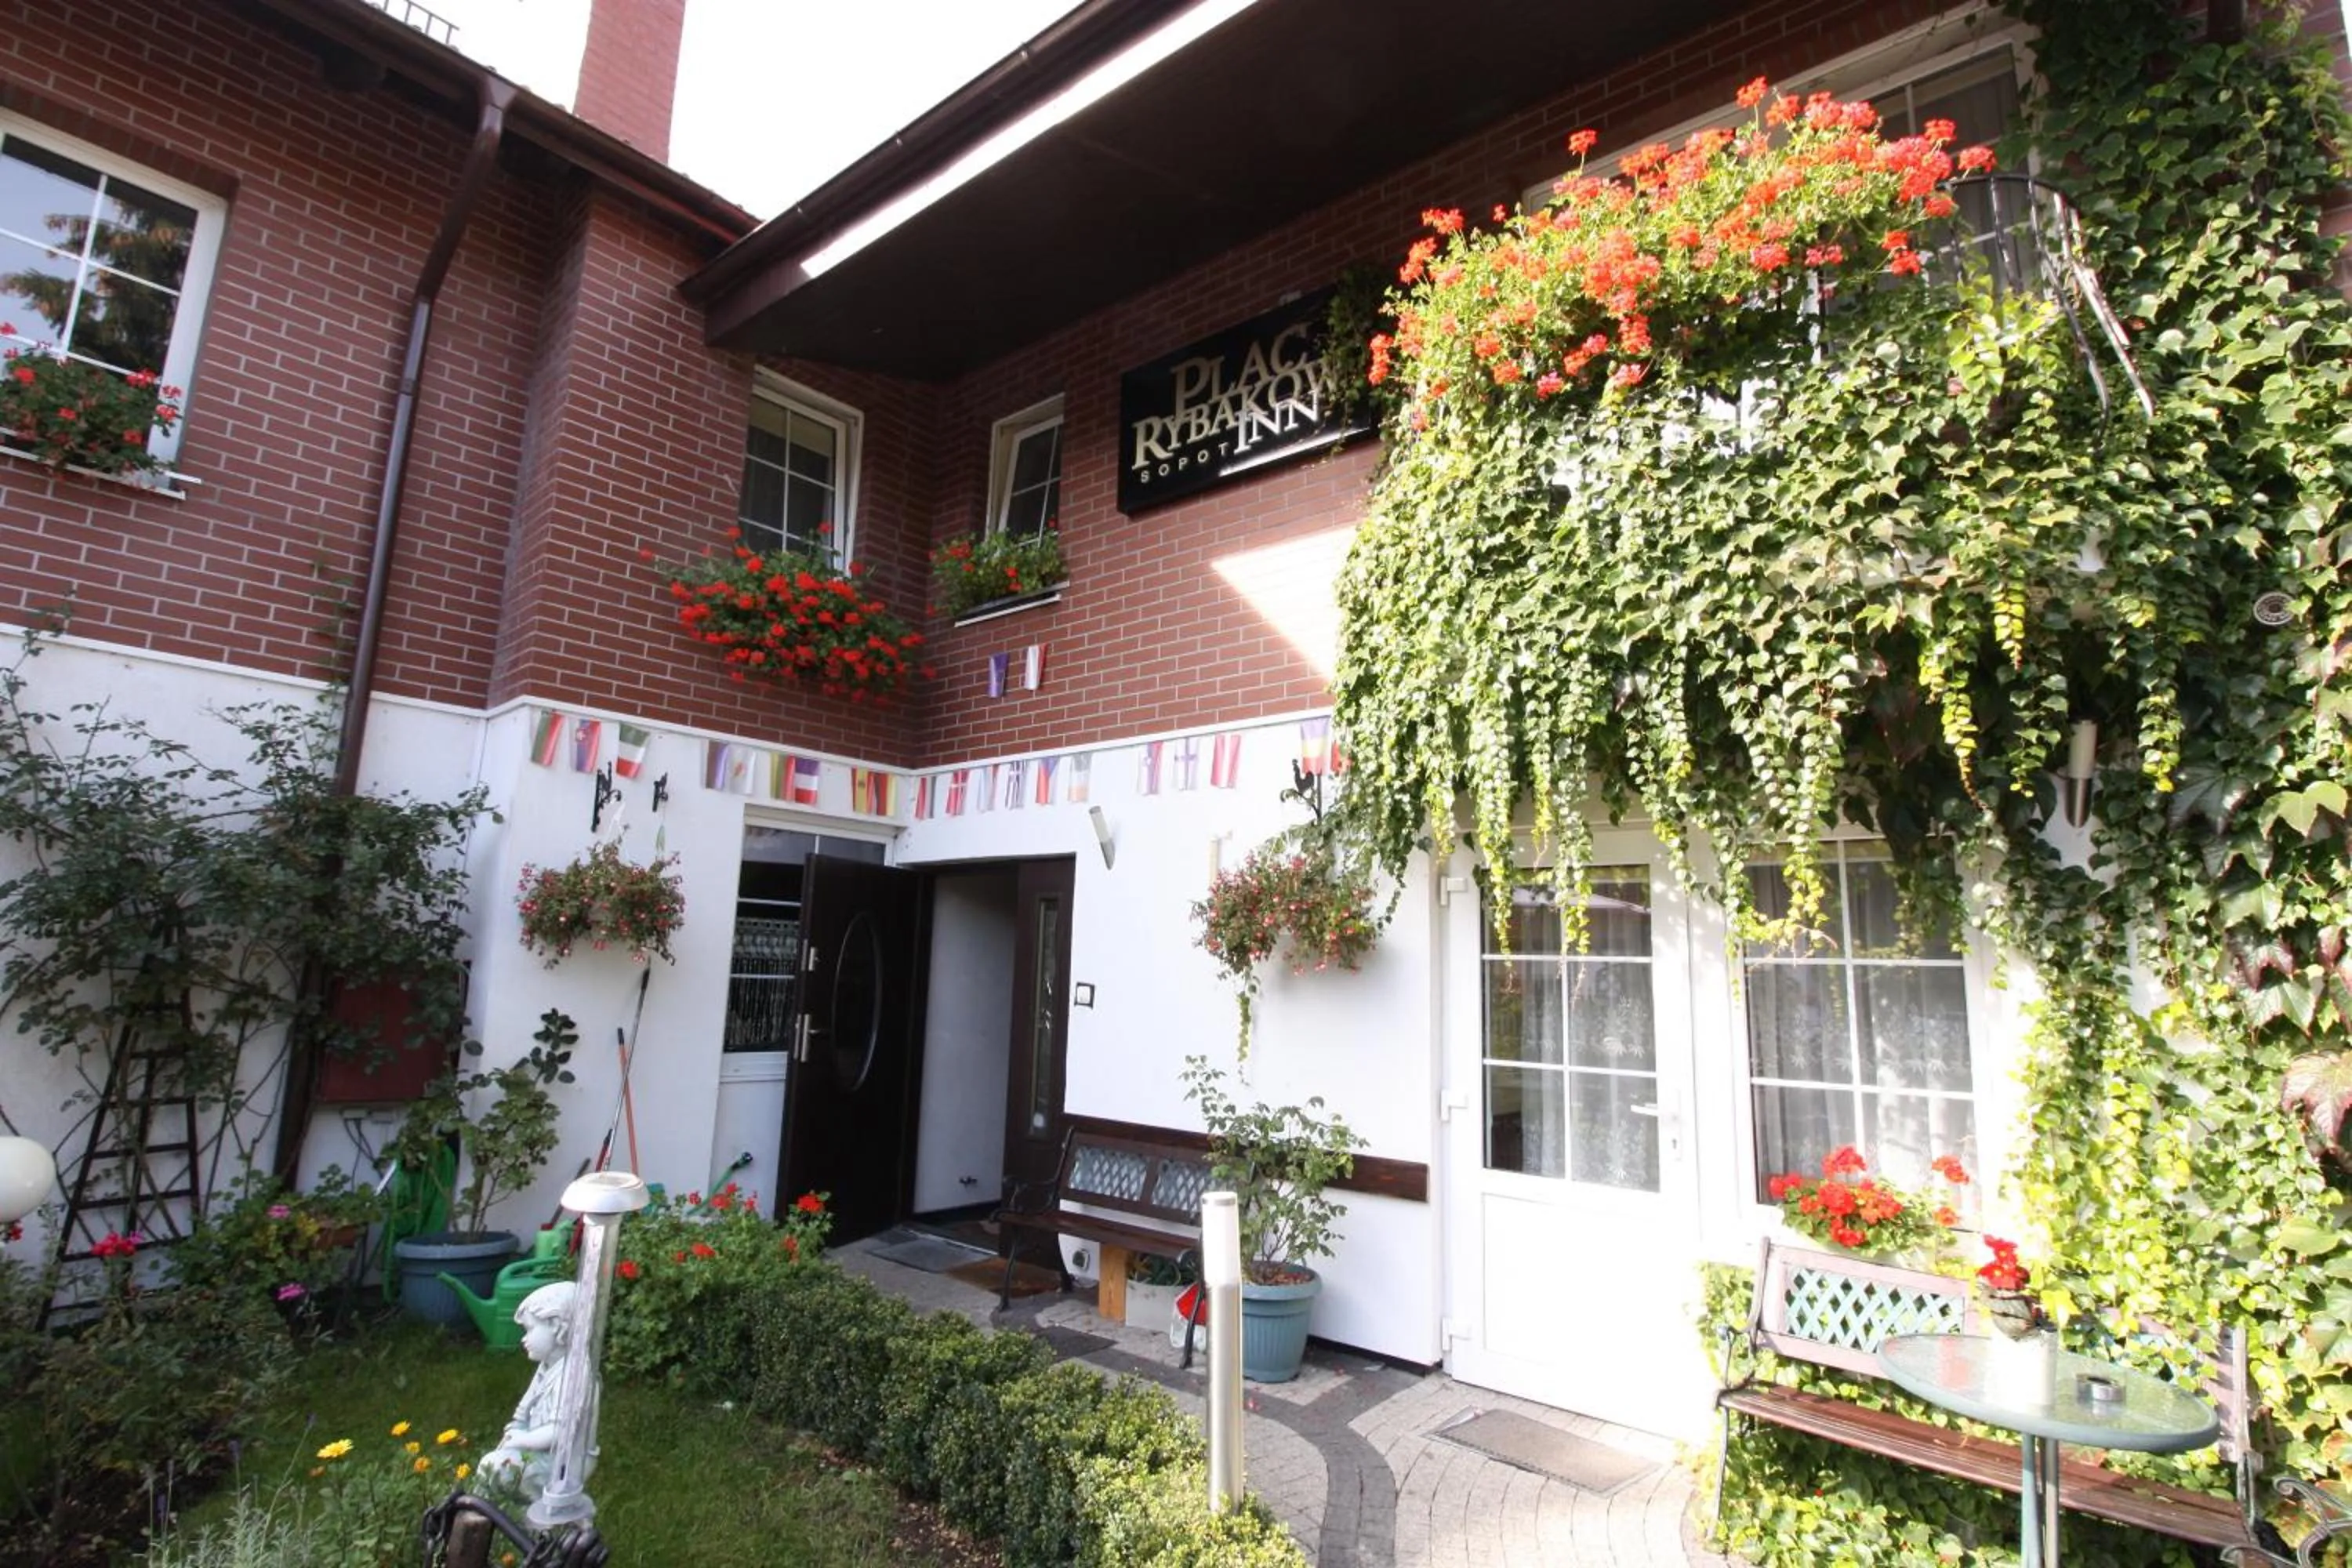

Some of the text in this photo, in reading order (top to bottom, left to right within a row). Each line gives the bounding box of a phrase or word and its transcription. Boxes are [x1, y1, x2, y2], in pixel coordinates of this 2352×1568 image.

[1171, 322, 1312, 417] PLAC
[1233, 390, 1320, 454] INN
[1141, 442, 1229, 483] SOPOT
